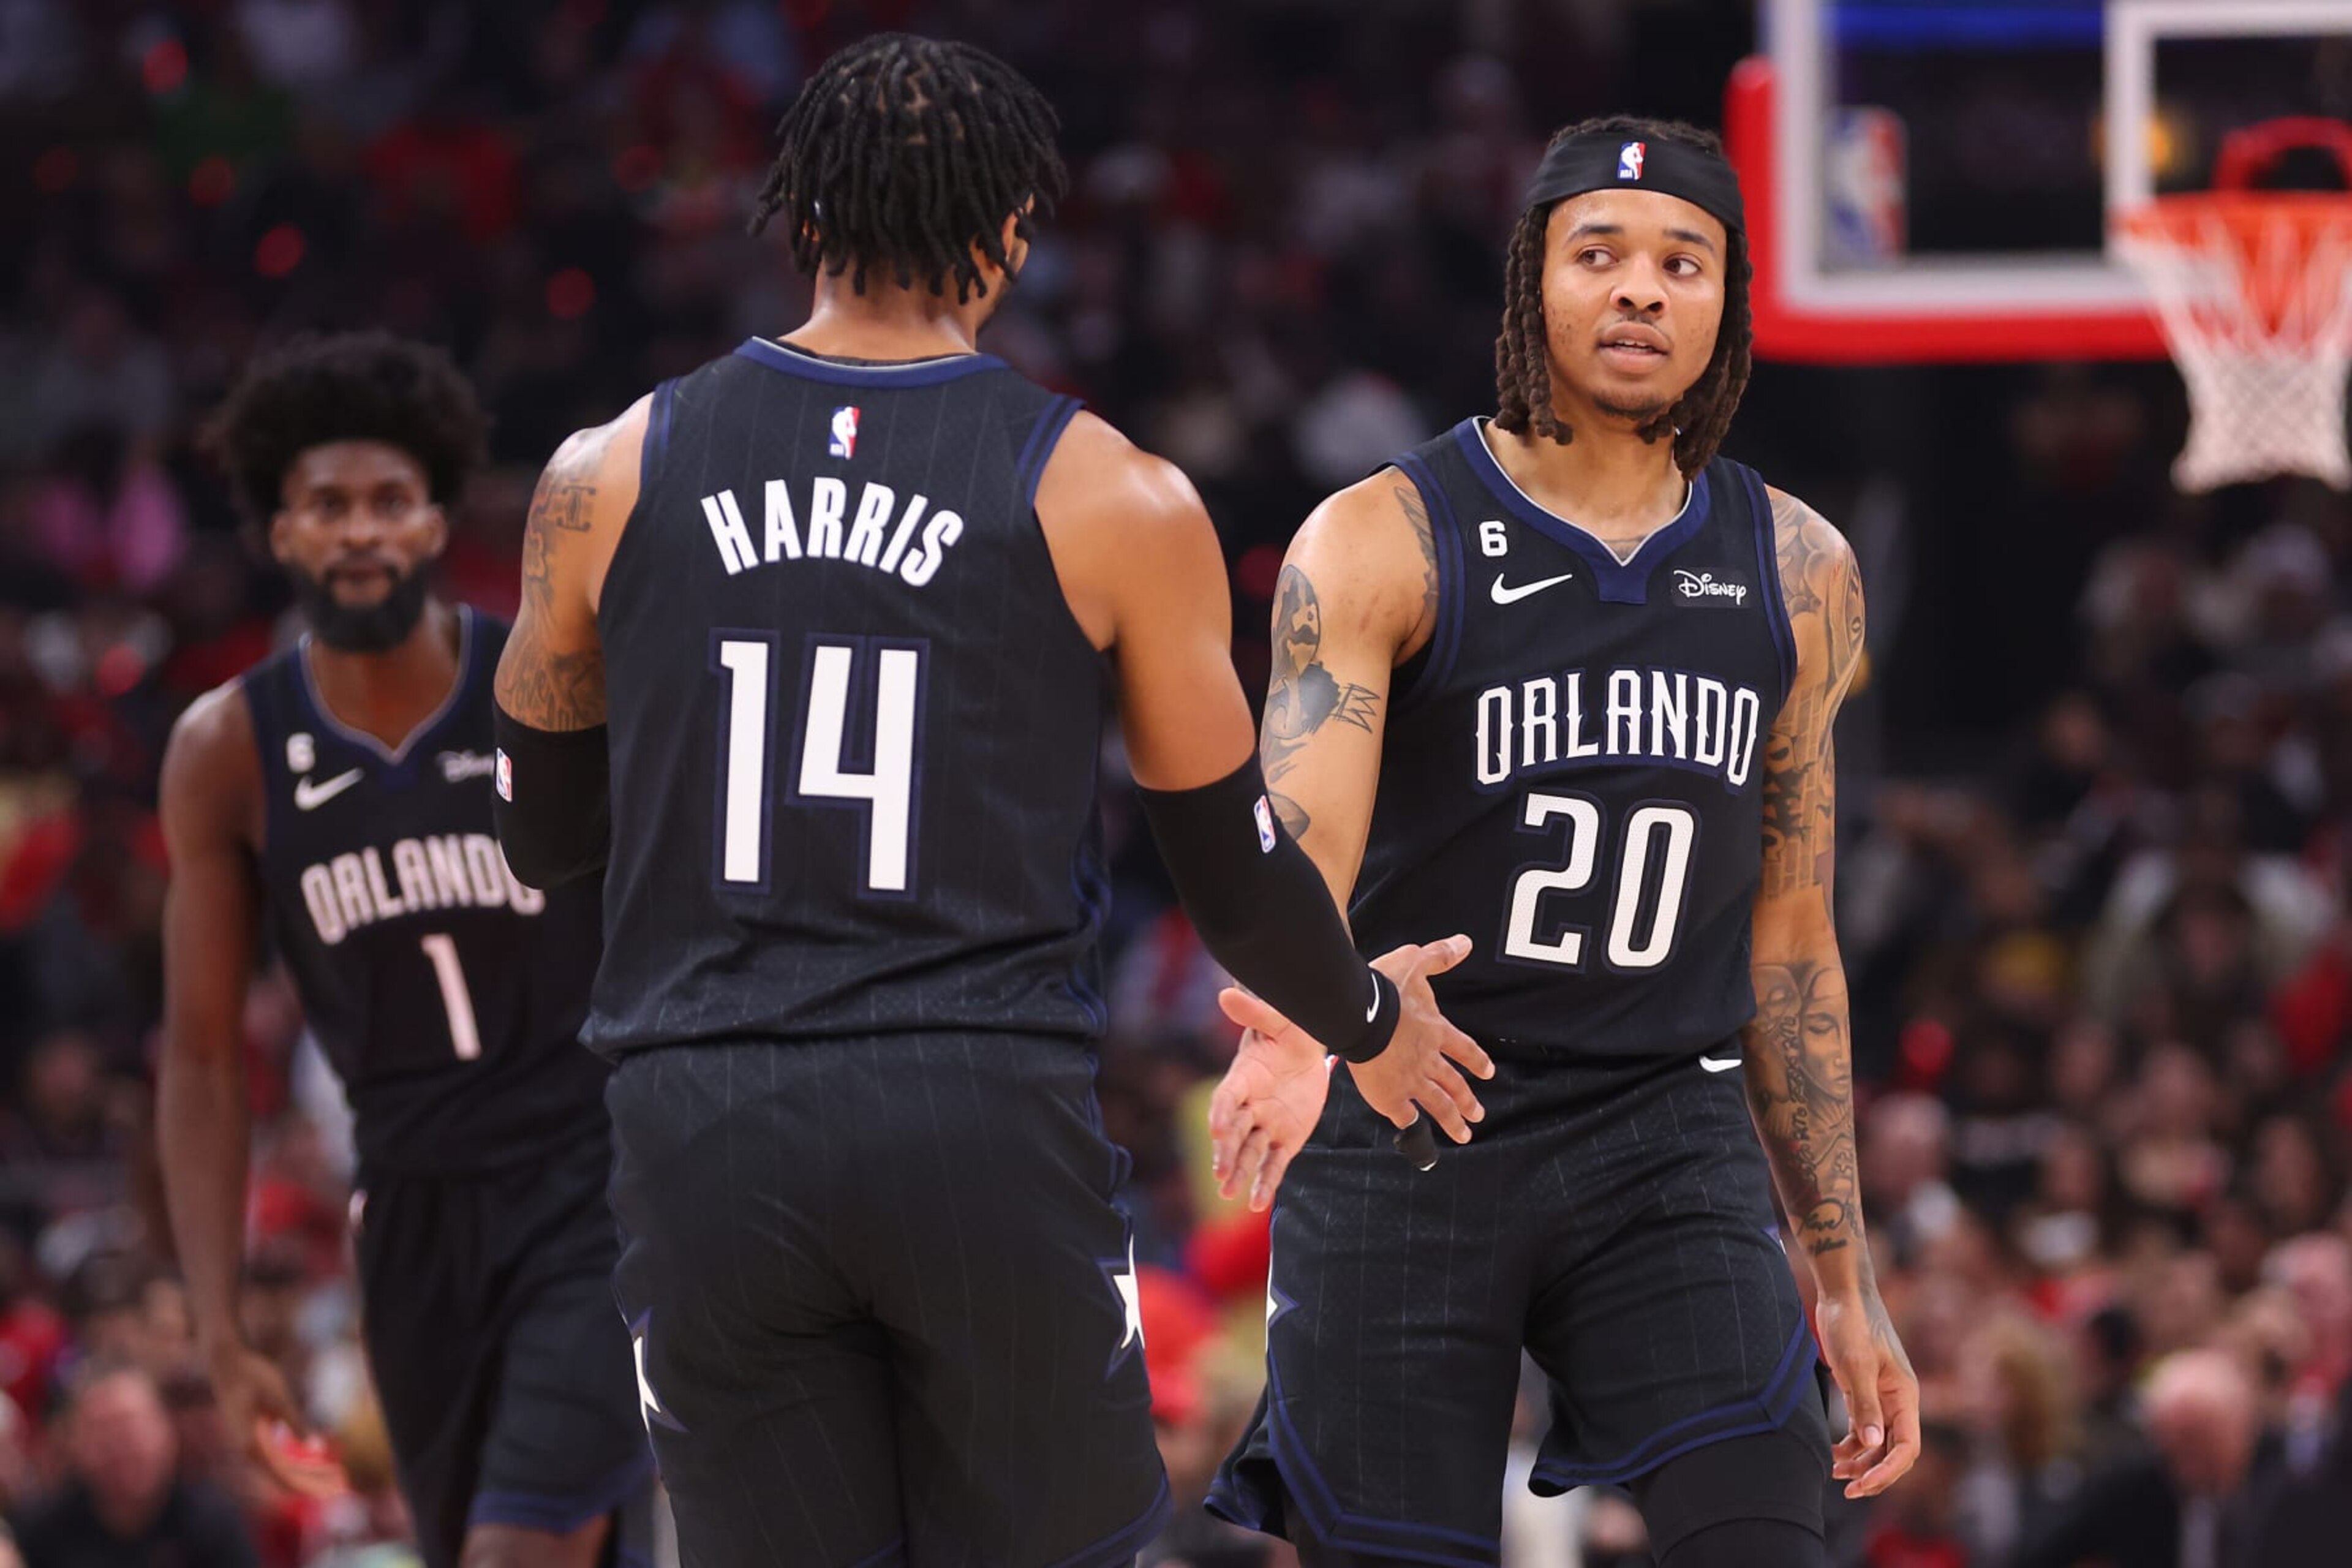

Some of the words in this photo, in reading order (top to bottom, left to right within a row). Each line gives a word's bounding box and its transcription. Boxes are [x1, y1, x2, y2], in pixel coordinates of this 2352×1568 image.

[701, 477, 963, 586] HARRIS
[1479, 521, 1508, 557] 6
[721, 641, 918, 891] 14
[1475, 669, 1760, 786] ORLANDO
[1504, 793, 1694, 968] 20
[421, 935, 481, 1060] 1
